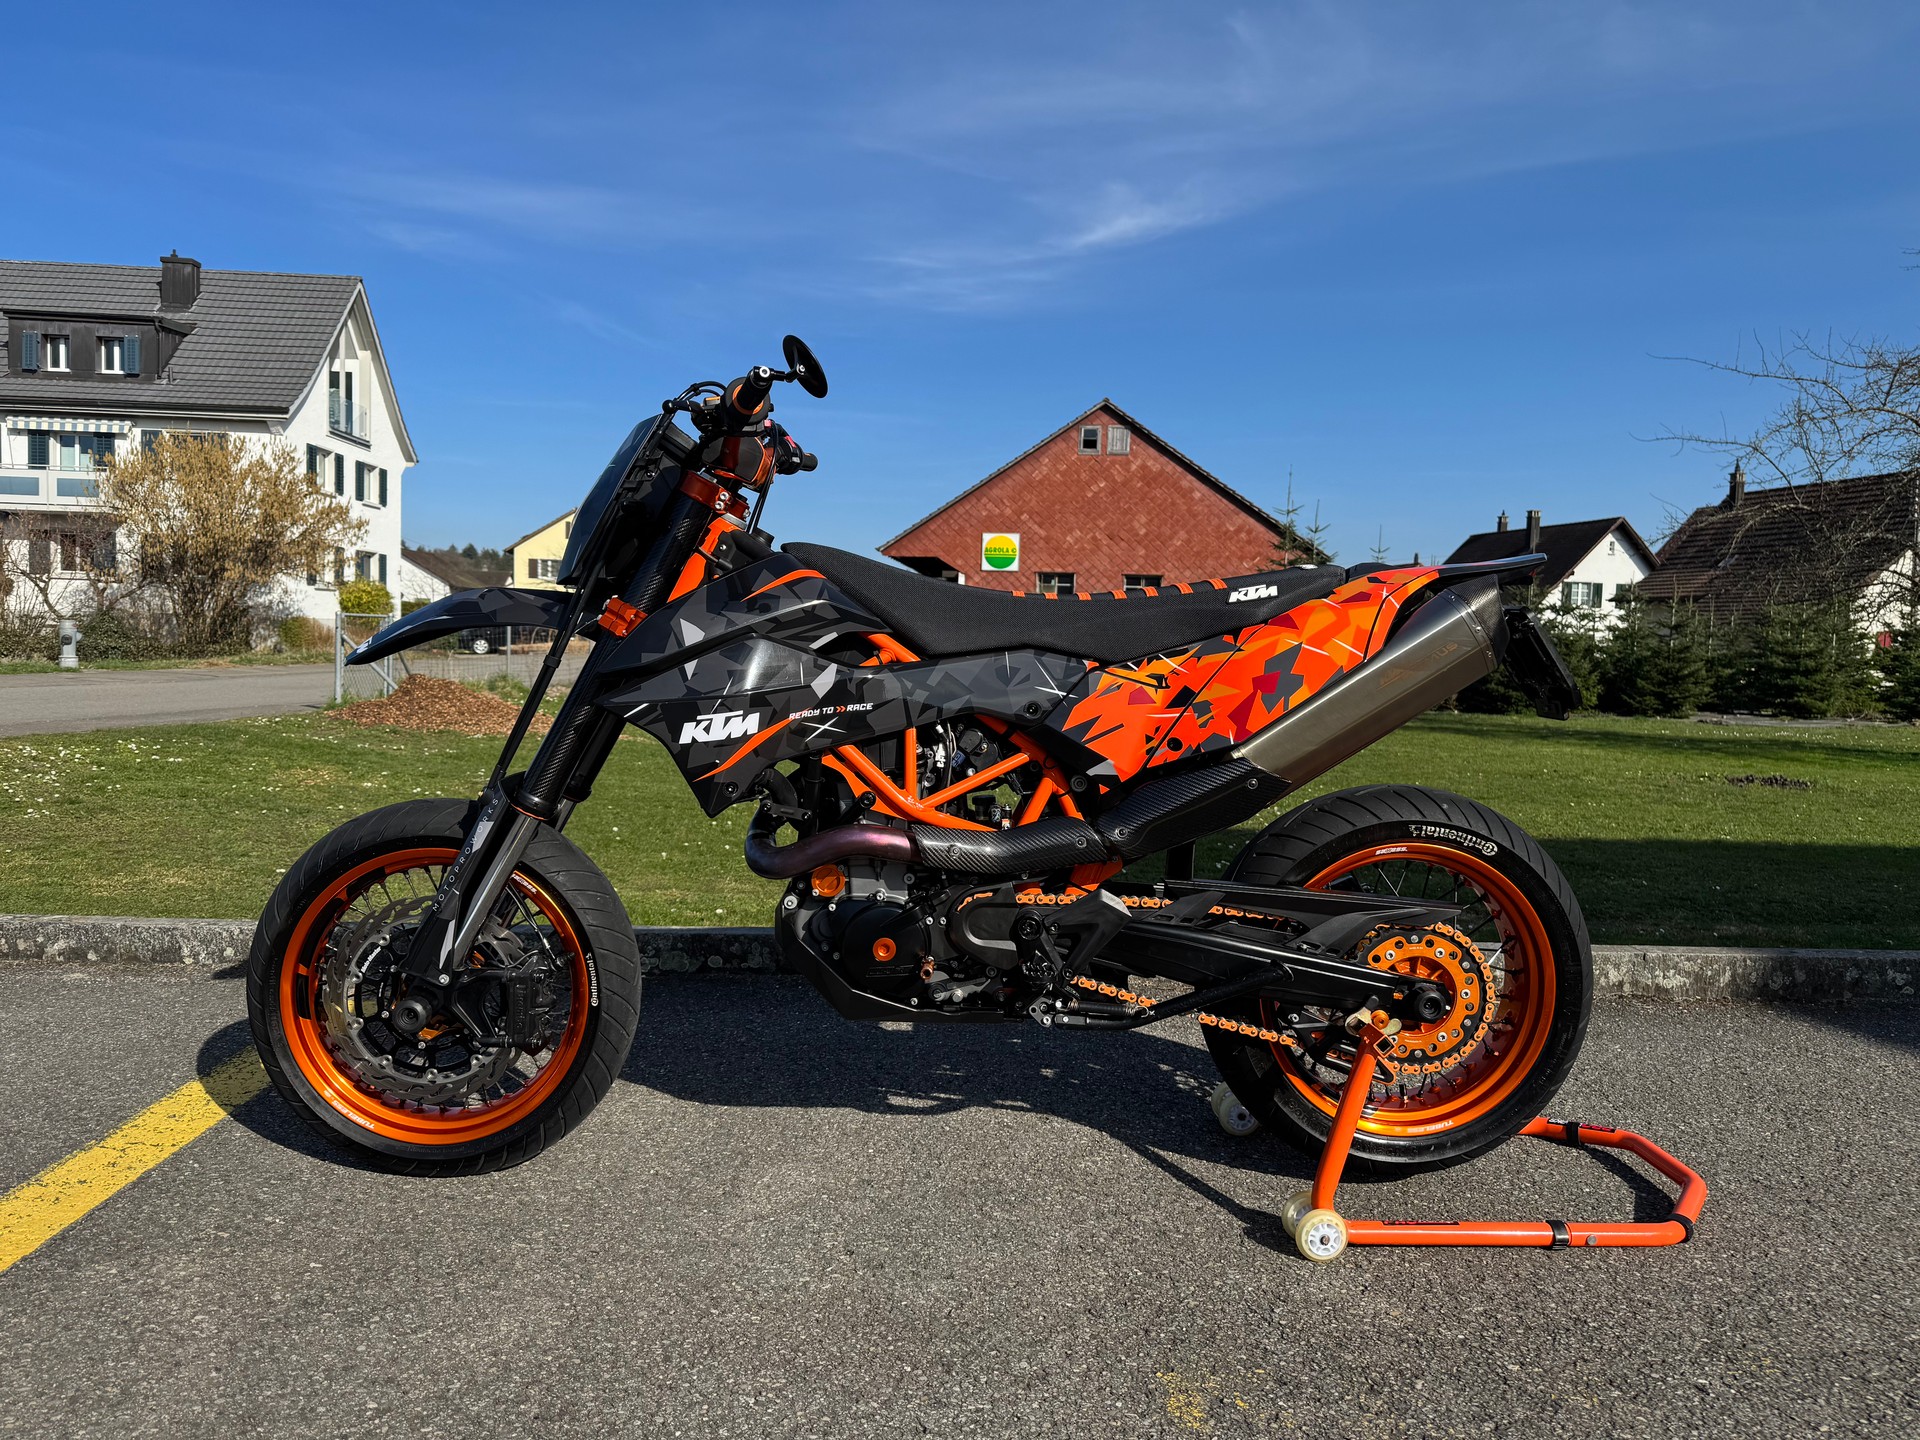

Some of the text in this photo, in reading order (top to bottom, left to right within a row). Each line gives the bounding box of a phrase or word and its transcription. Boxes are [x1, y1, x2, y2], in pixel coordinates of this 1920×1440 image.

[1229, 584, 1278, 603] KTM
[788, 702, 874, 720] READY TO RACE
[679, 710, 760, 744] KTM
[432, 799, 499, 912] MOTOPROWORKS
[1420, 825, 1498, 856] Continental
[586, 959, 599, 1007] Continental
[331, 1099, 375, 1130] TUBELESS
